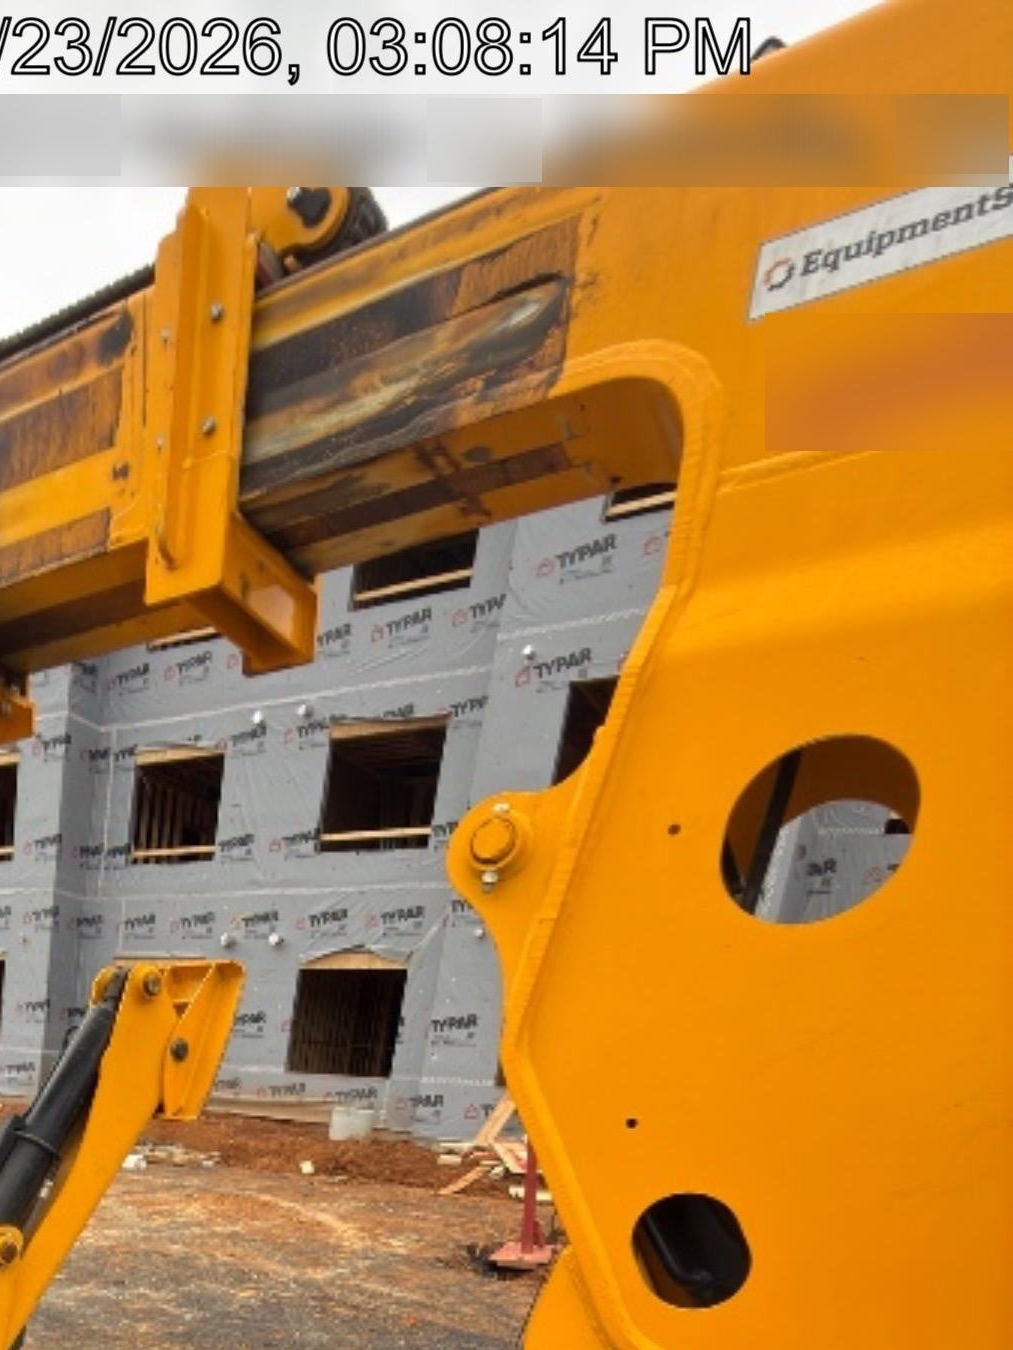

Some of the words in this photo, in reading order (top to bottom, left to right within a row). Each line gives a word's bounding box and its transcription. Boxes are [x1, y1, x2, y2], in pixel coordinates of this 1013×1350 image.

[556, 533, 617, 568] TYPAR
[534, 647, 591, 679] TYPAR
[431, 1013, 477, 1033] TYPAR
